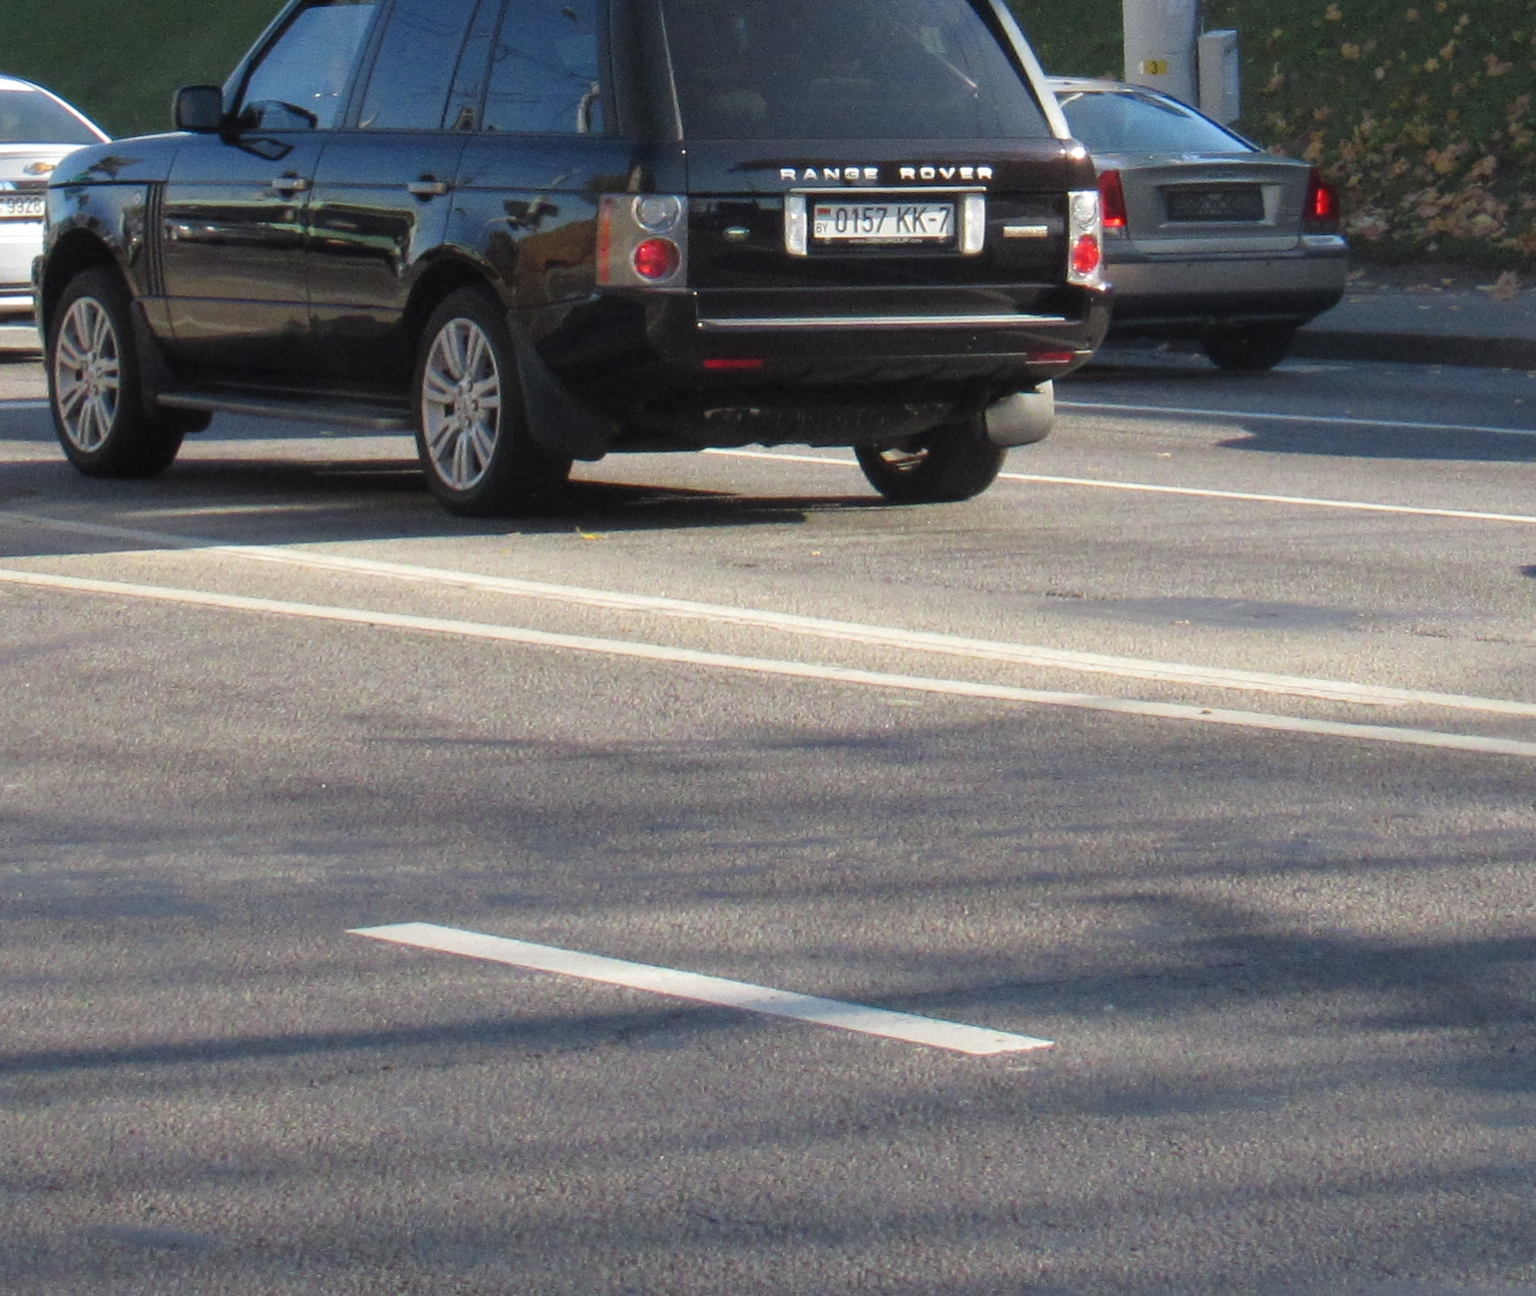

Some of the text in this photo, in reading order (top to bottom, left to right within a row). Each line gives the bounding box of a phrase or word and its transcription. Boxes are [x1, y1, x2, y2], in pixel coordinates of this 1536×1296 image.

[780, 167, 993, 181] RANGE ROVER
[834, 206, 952, 233] 0157 KK-7
